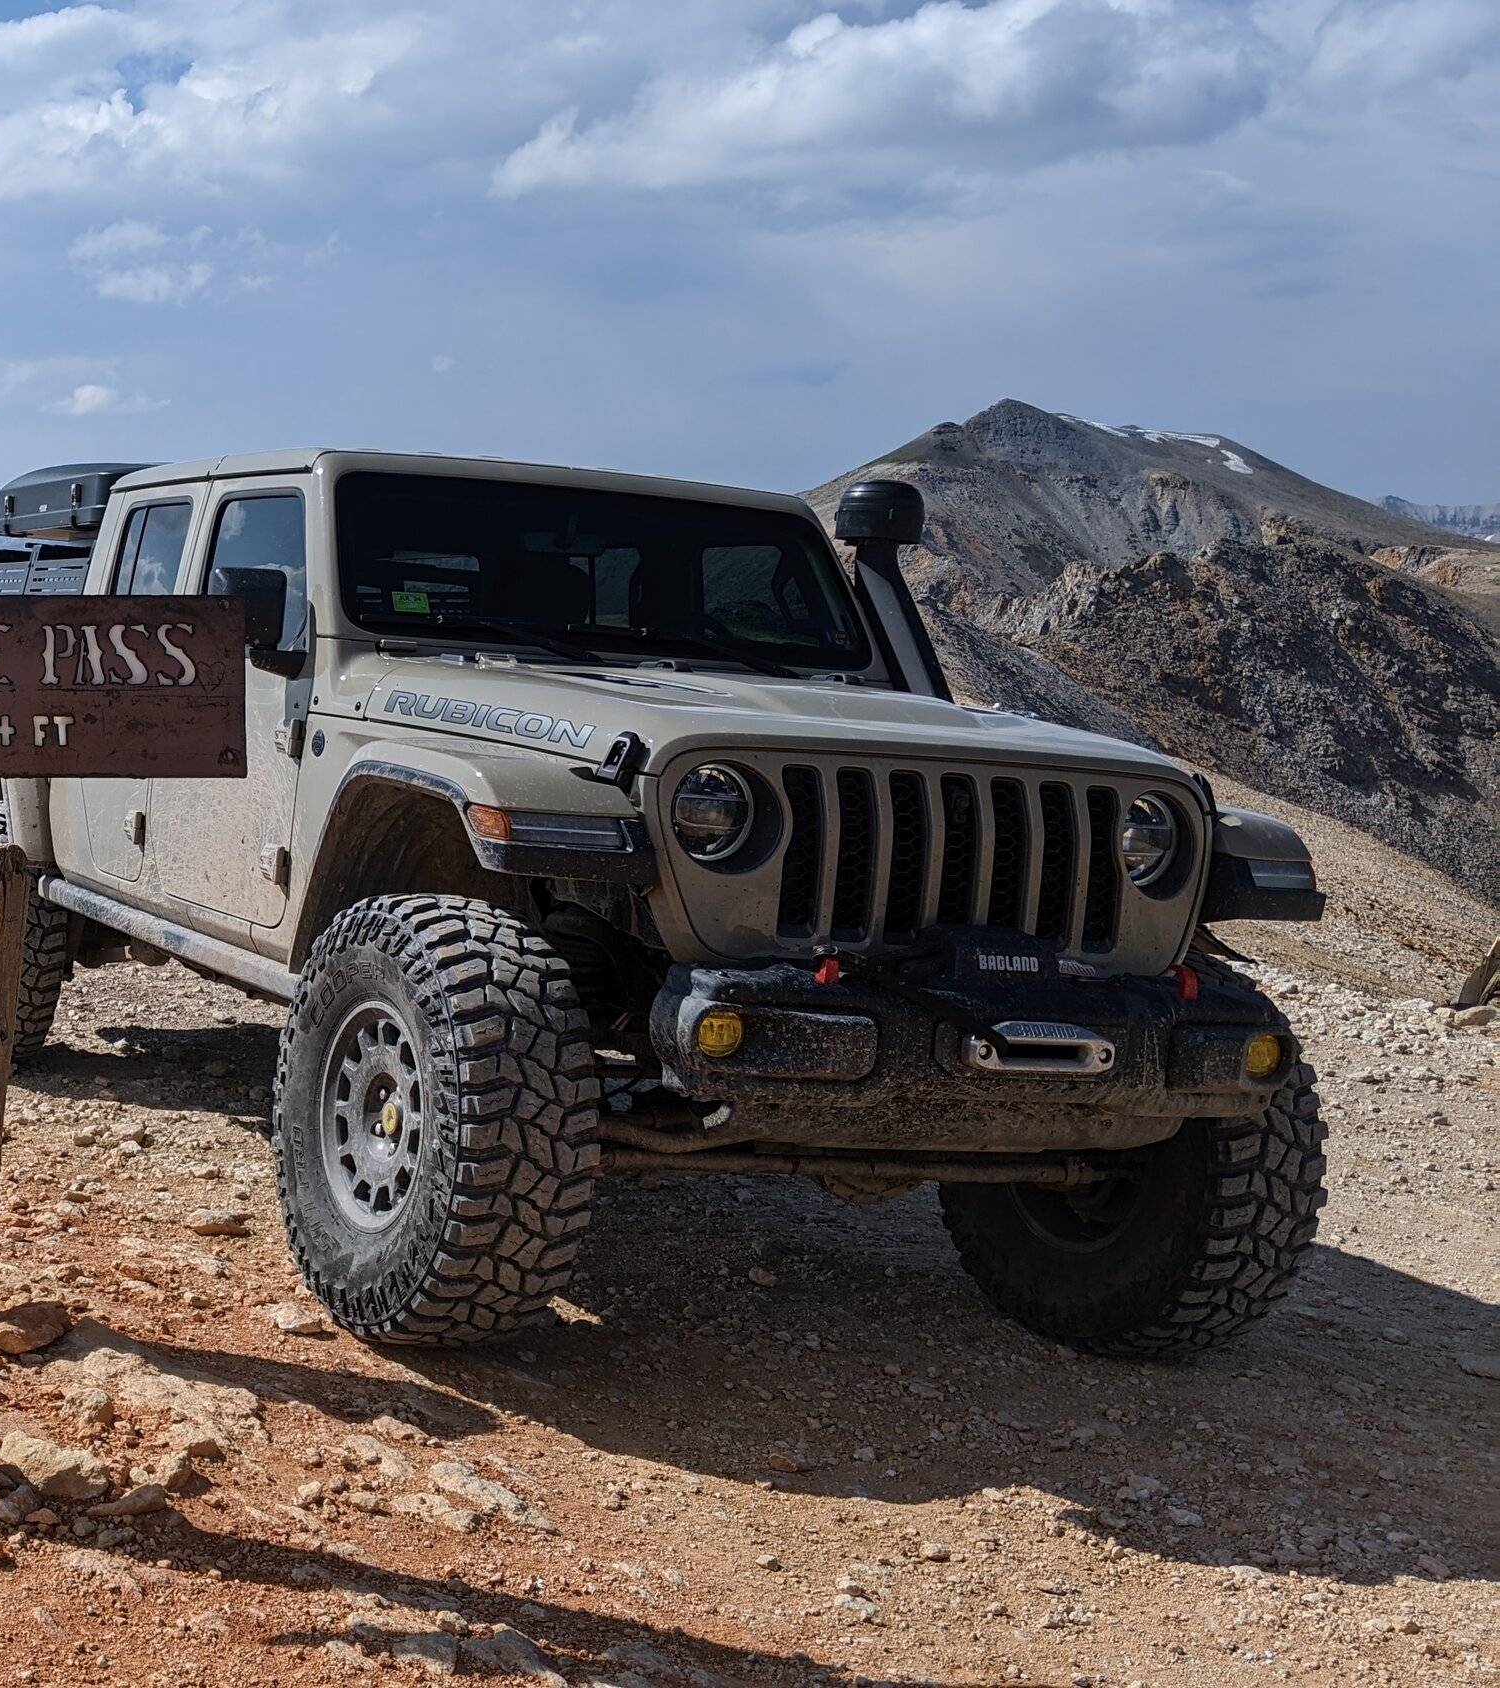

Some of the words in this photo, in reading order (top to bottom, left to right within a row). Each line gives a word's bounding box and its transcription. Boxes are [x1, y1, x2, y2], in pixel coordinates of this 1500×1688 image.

[40, 623, 196, 686] PASS
[33, 714, 74, 747] FT
[383, 689, 596, 749] RUBICON
[978, 954, 1039, 973] BADLAND
[309, 959, 387, 1029] COOPER
